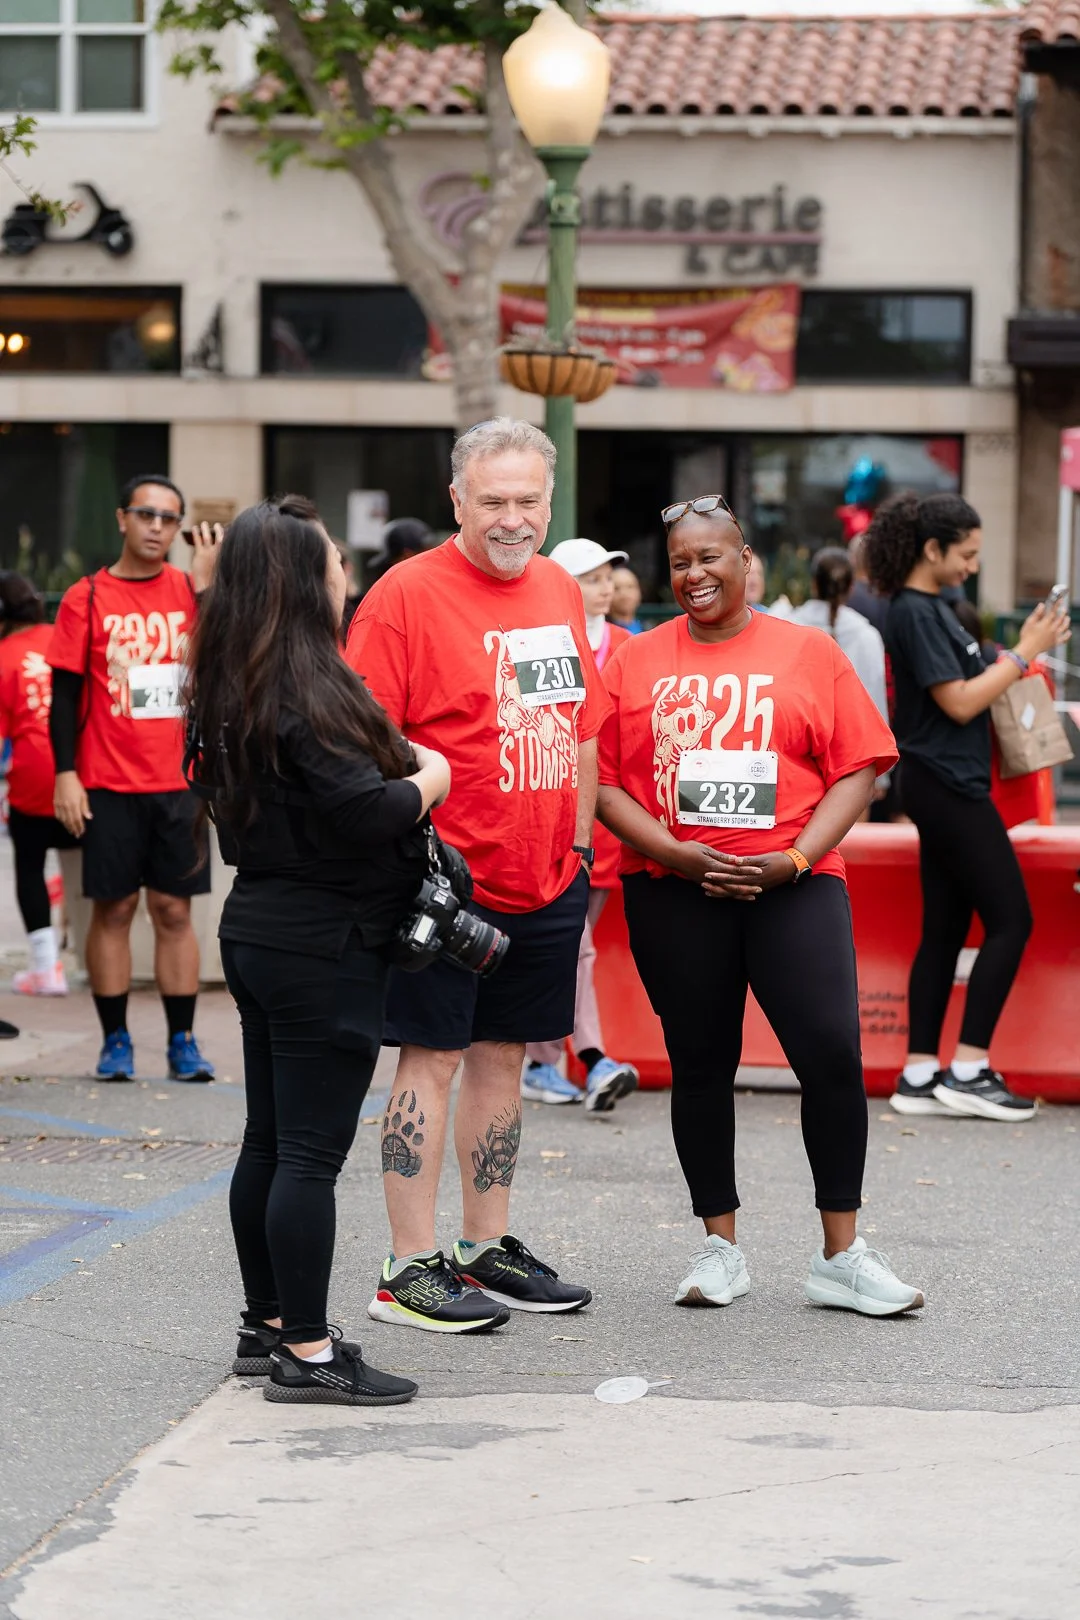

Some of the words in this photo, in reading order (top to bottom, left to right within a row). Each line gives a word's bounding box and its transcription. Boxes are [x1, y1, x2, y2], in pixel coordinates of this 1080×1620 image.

[531, 657, 576, 691] 230
[498, 726, 569, 793] STOMP
[698, 783, 756, 814] 232
[696, 815, 730, 824] STRAWBERRY
[731, 817, 749, 825] STOMP
